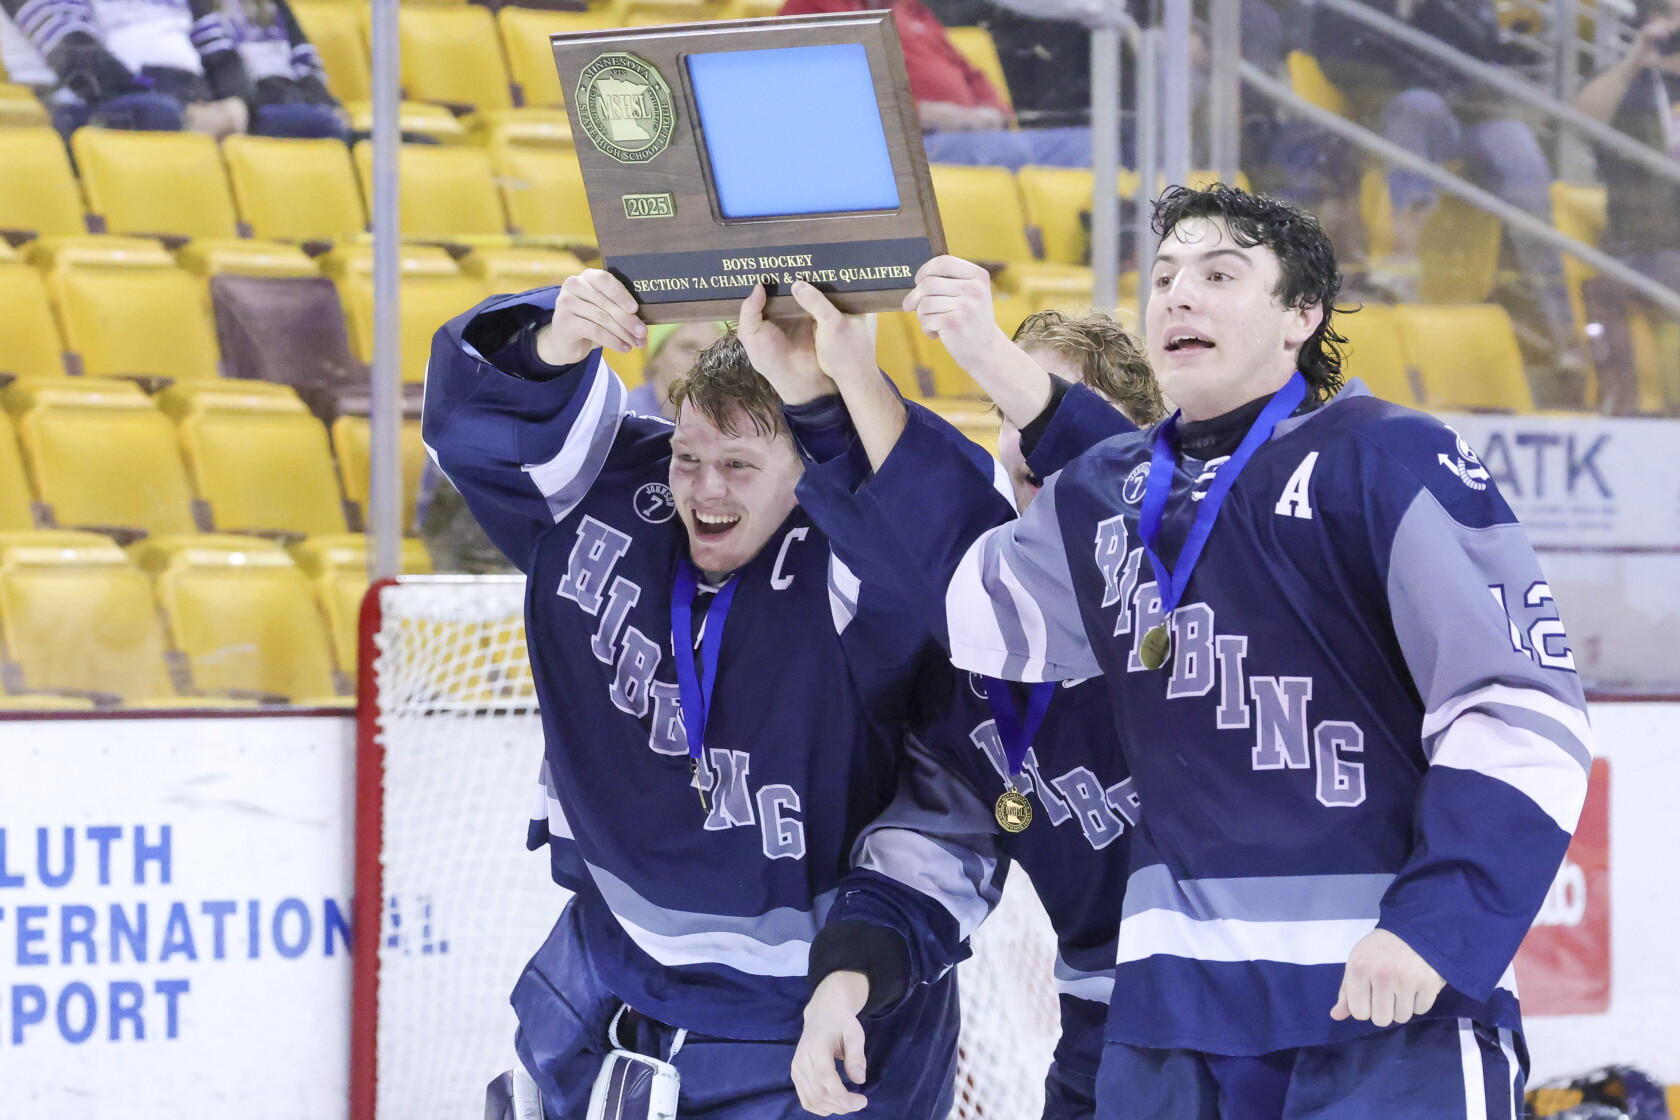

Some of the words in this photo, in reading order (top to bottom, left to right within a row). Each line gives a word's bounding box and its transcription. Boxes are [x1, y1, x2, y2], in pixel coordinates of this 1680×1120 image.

[585, 57, 650, 80] MINNESOTA
[580, 104, 598, 138] STATE
[596, 137, 621, 158] HIGH
[623, 145, 659, 161] SCHOOL
[658, 101, 670, 144] LEAGUE
[597, 94, 652, 120] MSHSL
[628, 198, 668, 216] 2025
[633, 277, 690, 292] SECTION
[692, 276, 709, 289] 7A
[710, 273, 780, 287] CHAMPION
[783, 273, 794, 284] &
[795, 269, 838, 283] STATE
[840, 265, 912, 281] QUALIFIER
[722, 257, 757, 271] BOYS
[760, 254, 813, 269] HOCKEY
[646, 485, 675, 507] JOHNSON
[1130, 475, 1144, 500] 7
[1274, 452, 1320, 520] A
[1482, 433, 1615, 499] ATK
[642, 494, 664, 517] 7
[771, 527, 810, 591] C
[557, 514, 807, 861] HIBBNG
[1094, 514, 1367, 808] HIBBING
[0, 825, 172, 889] LUTH
[0, 896, 449, 967] ERNATION
[0, 979, 191, 1046] PORT
